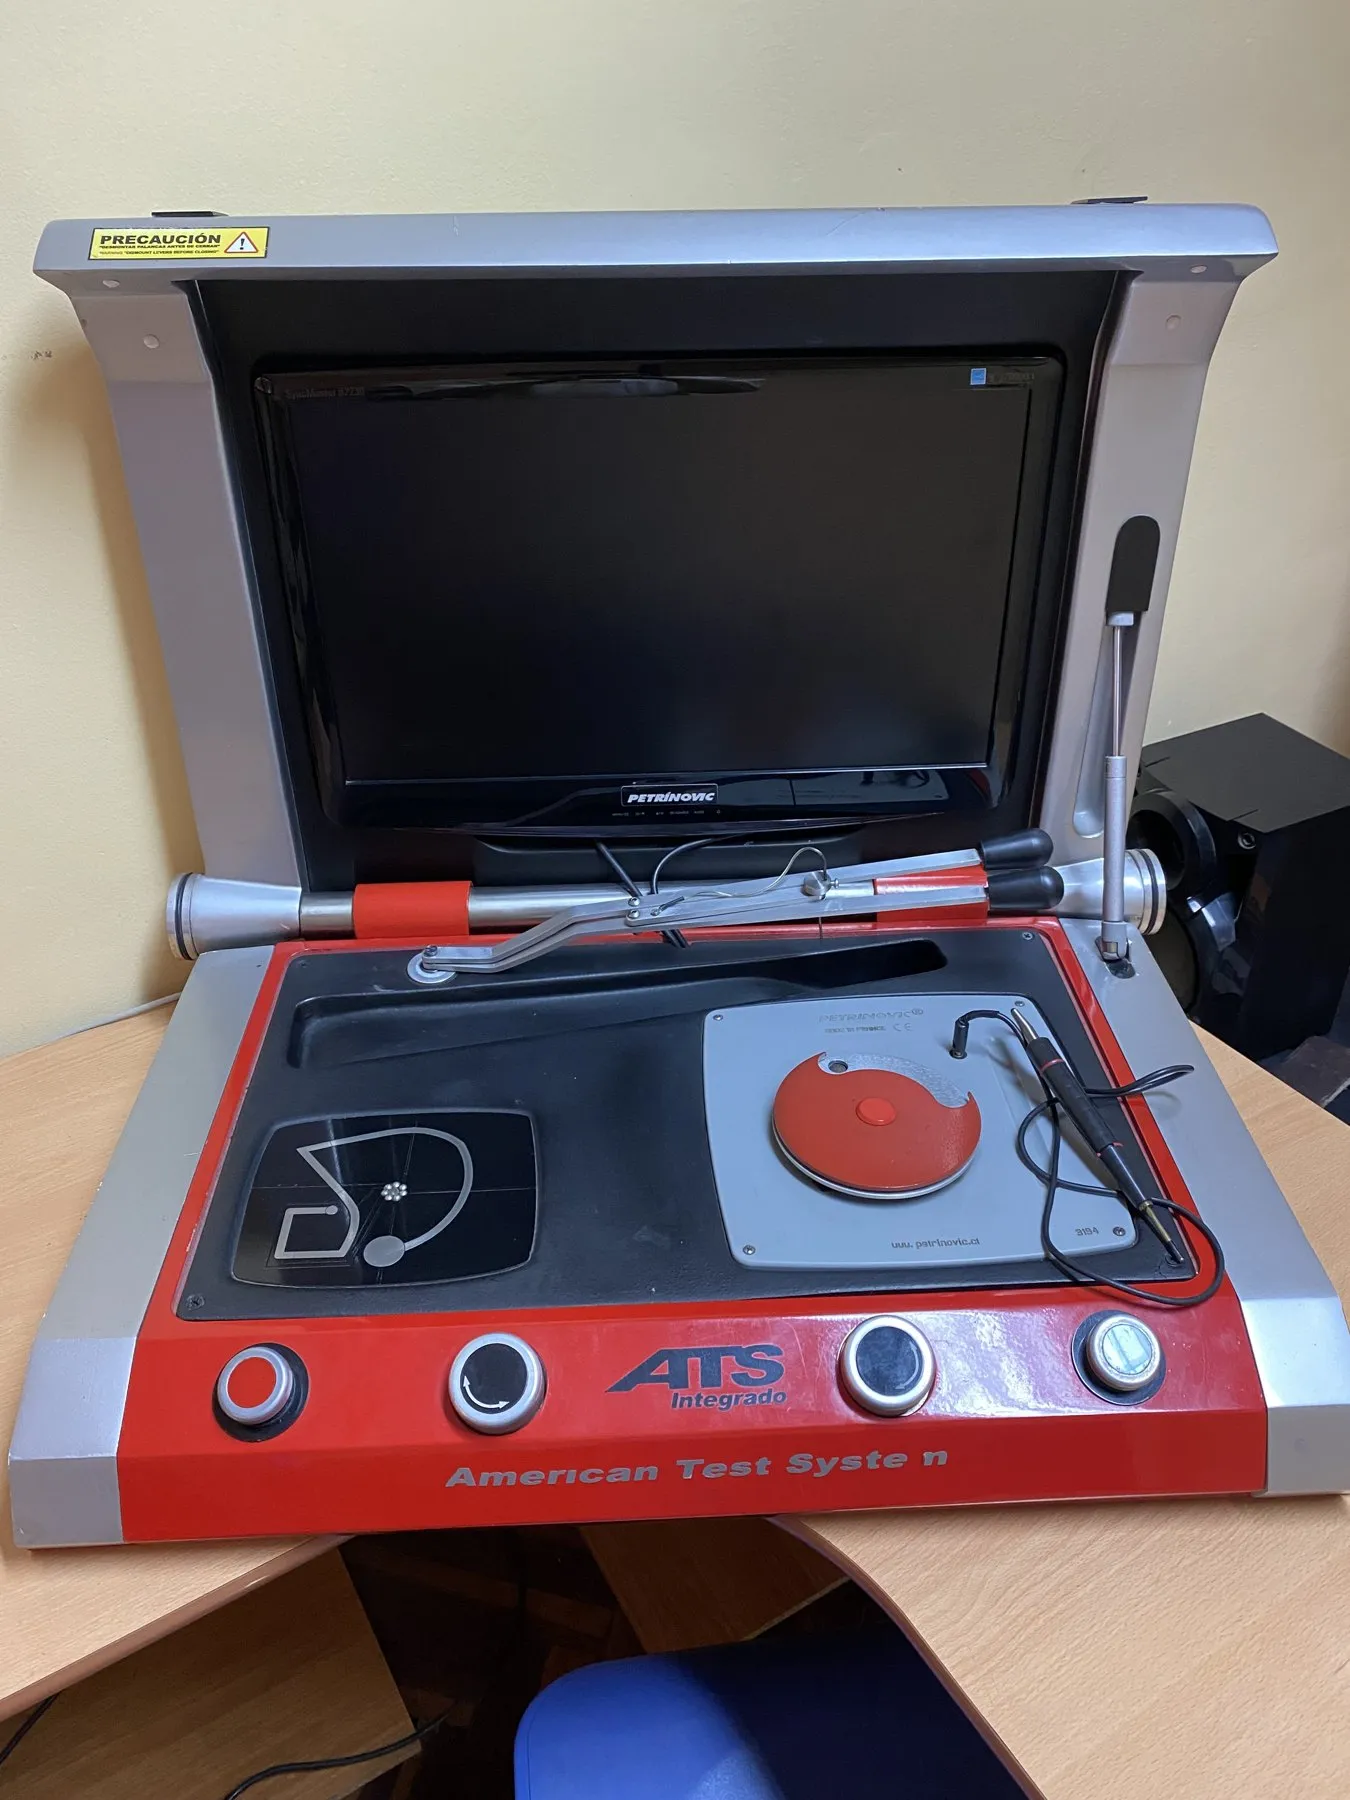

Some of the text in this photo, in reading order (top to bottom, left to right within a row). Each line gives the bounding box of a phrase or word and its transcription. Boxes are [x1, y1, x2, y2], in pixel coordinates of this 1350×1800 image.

[100, 233, 221, 245] PRECAUCIÓN
[605, 1343, 785, 1392] ATS
[671, 1388, 787, 1411] Integrado
[445, 1466, 658, 1487] American
[676, 1457, 772, 1479] Test
